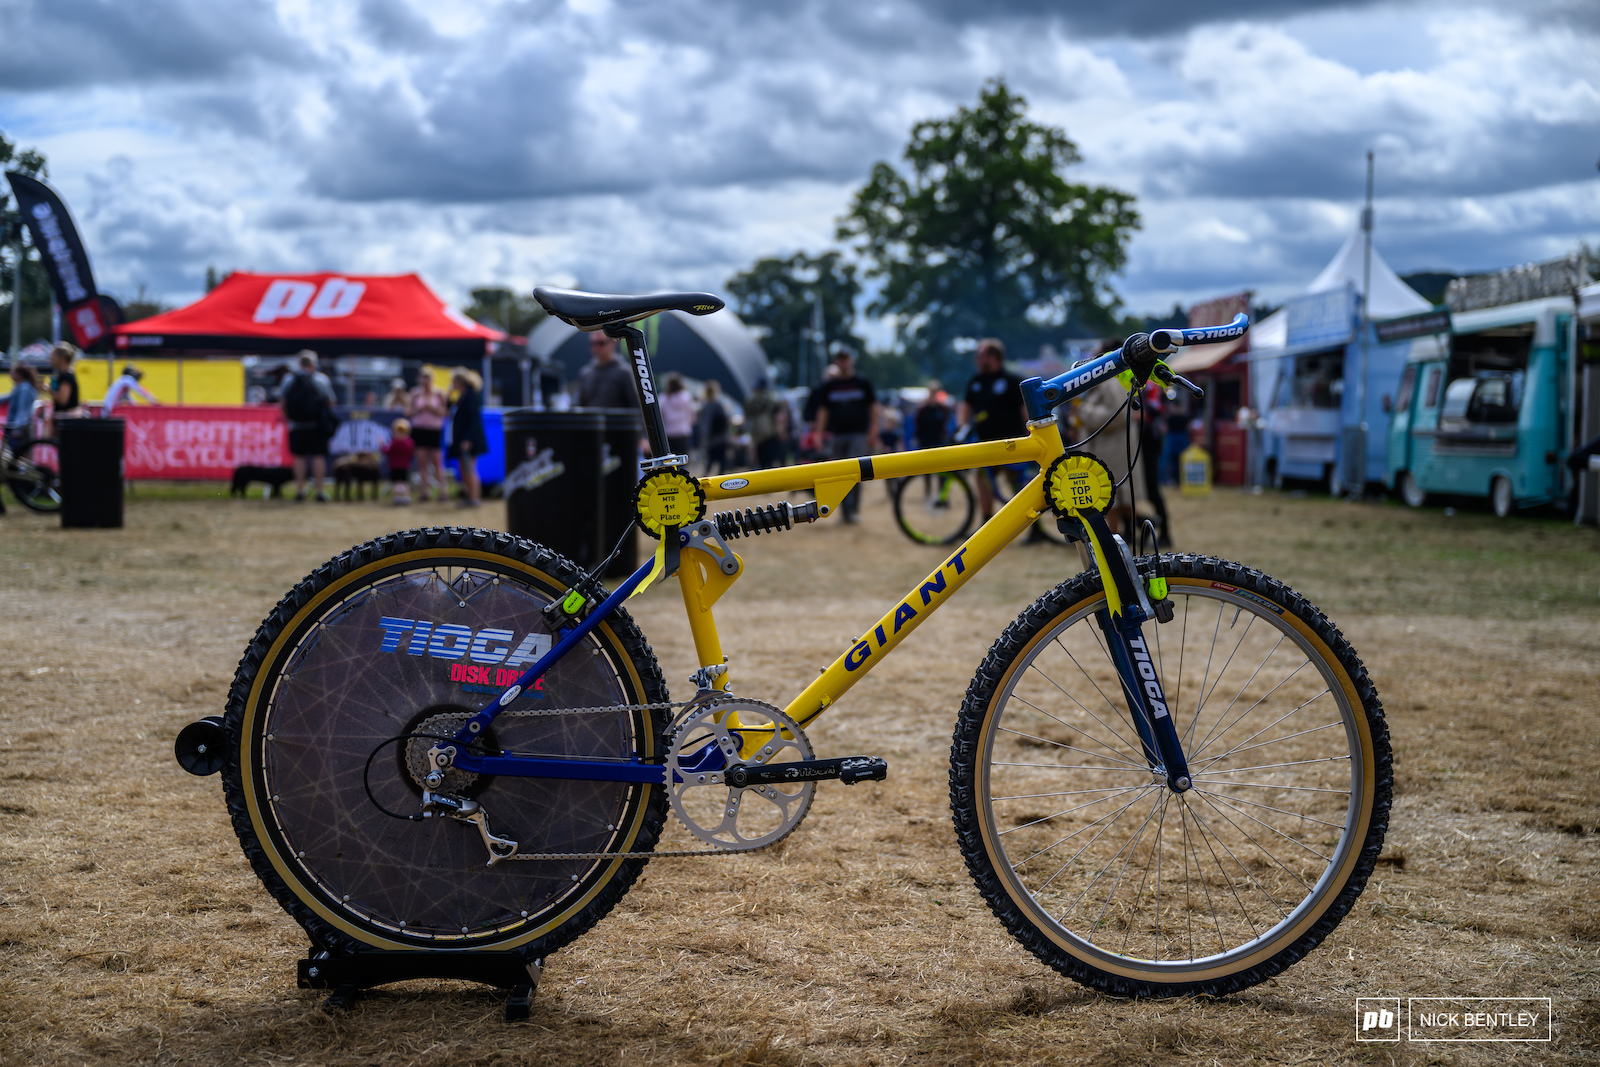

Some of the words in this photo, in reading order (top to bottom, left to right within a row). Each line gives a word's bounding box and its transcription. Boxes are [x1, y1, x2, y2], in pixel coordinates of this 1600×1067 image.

[251, 277, 368, 324] pb
[1205, 326, 1244, 339] TIOGA
[633, 347, 655, 405] TIOGA
[1063, 359, 1117, 393] TIOGA
[165, 420, 284, 445] BRITISH
[164, 444, 284, 468] CYCLING
[1070, 485, 1091, 496] TOP
[1071, 495, 1093, 505] TEN
[660, 513, 681, 521] Place
[664, 504, 675, 513] 1st
[844, 546, 968, 672] GIANT
[379, 616, 553, 667] TIOGA
[451, 663, 491, 685] DISK
[495, 668, 545, 691] DRE
[1129, 635, 1169, 720] TIOGA
